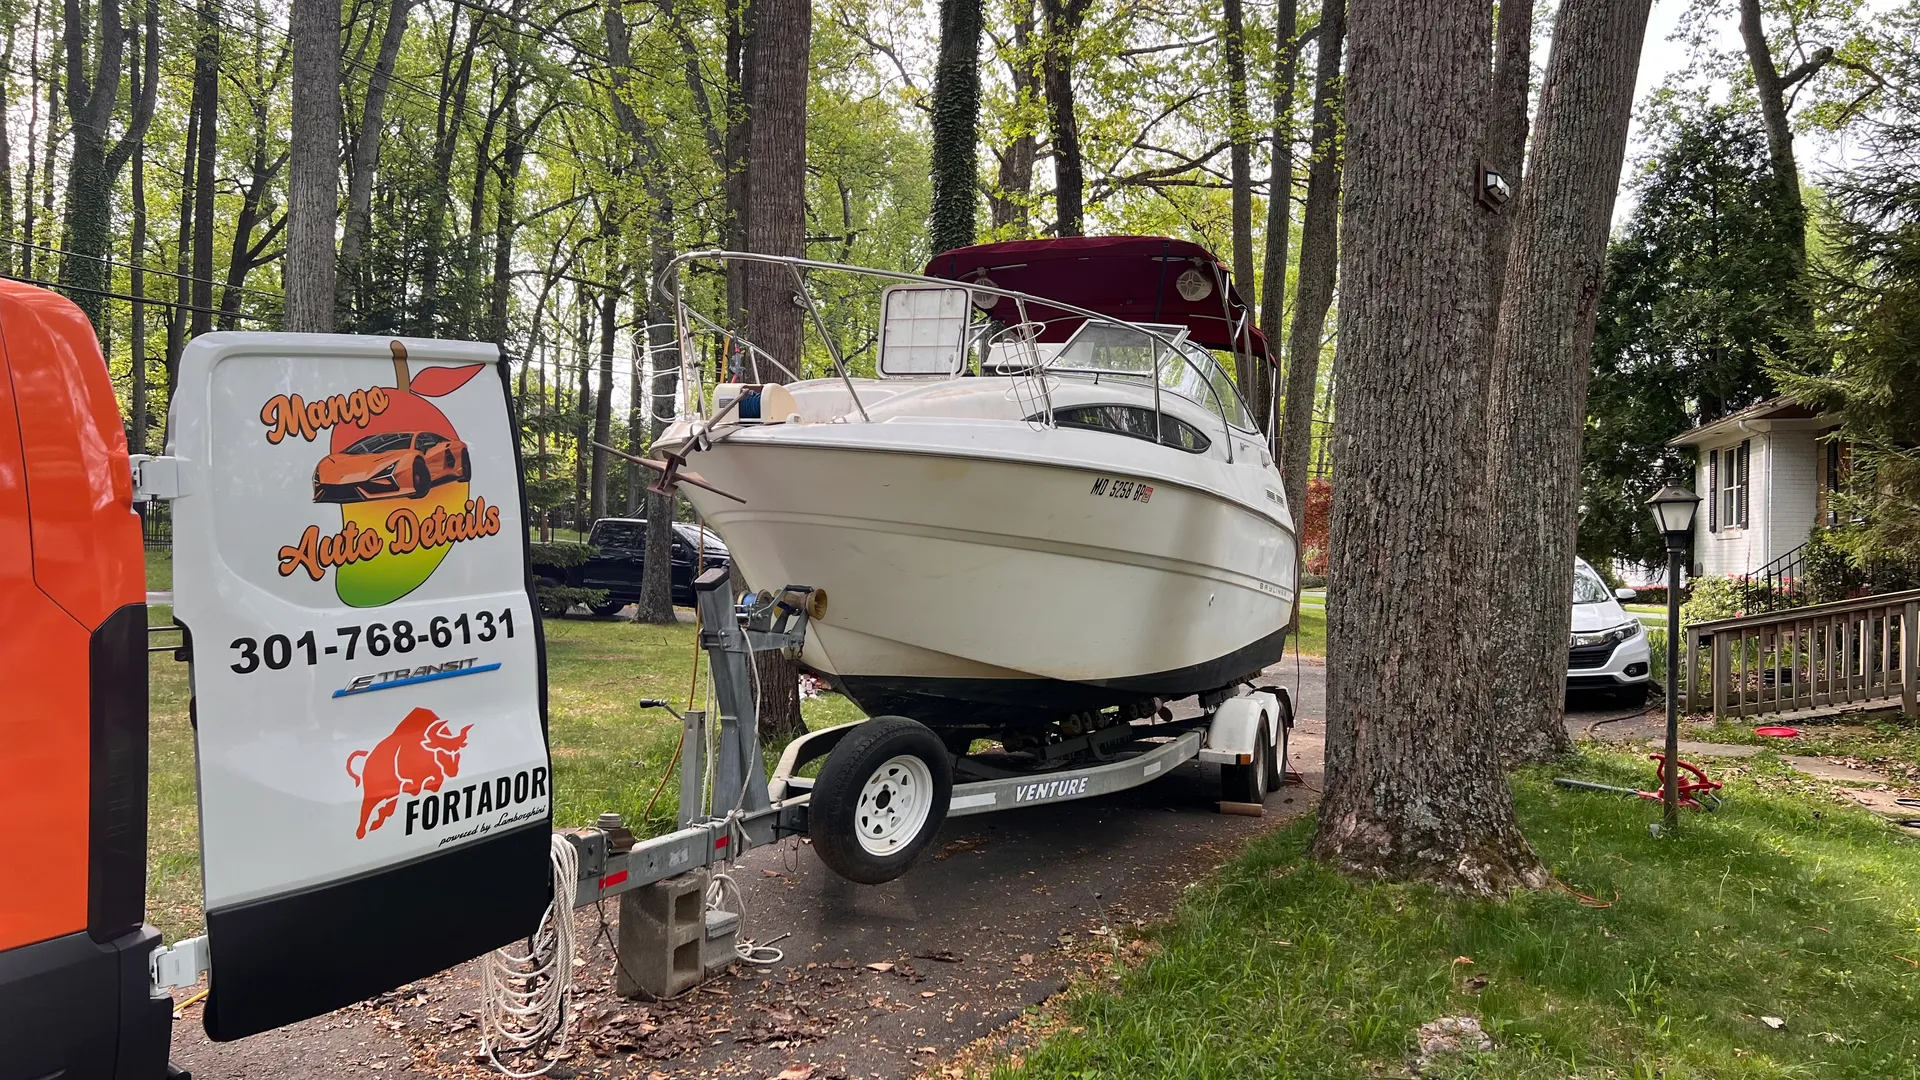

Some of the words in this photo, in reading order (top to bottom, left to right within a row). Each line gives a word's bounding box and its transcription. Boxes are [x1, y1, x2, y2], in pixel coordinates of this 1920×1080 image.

[259, 385, 390, 445] Mango
[1090, 478, 1109, 496] MD
[1109, 480, 1134, 499] 5258
[278, 521, 383, 581] Auto
[385, 496, 501, 554] Details
[229, 608, 515, 675] 301-768-6131
[405, 766, 547, 836] FORTADOR
[1015, 777, 1089, 803] VENTURE
[438, 825, 480, 847] powered
[480, 823, 492, 834] by
[494, 805, 546, 828] Lamborghini
